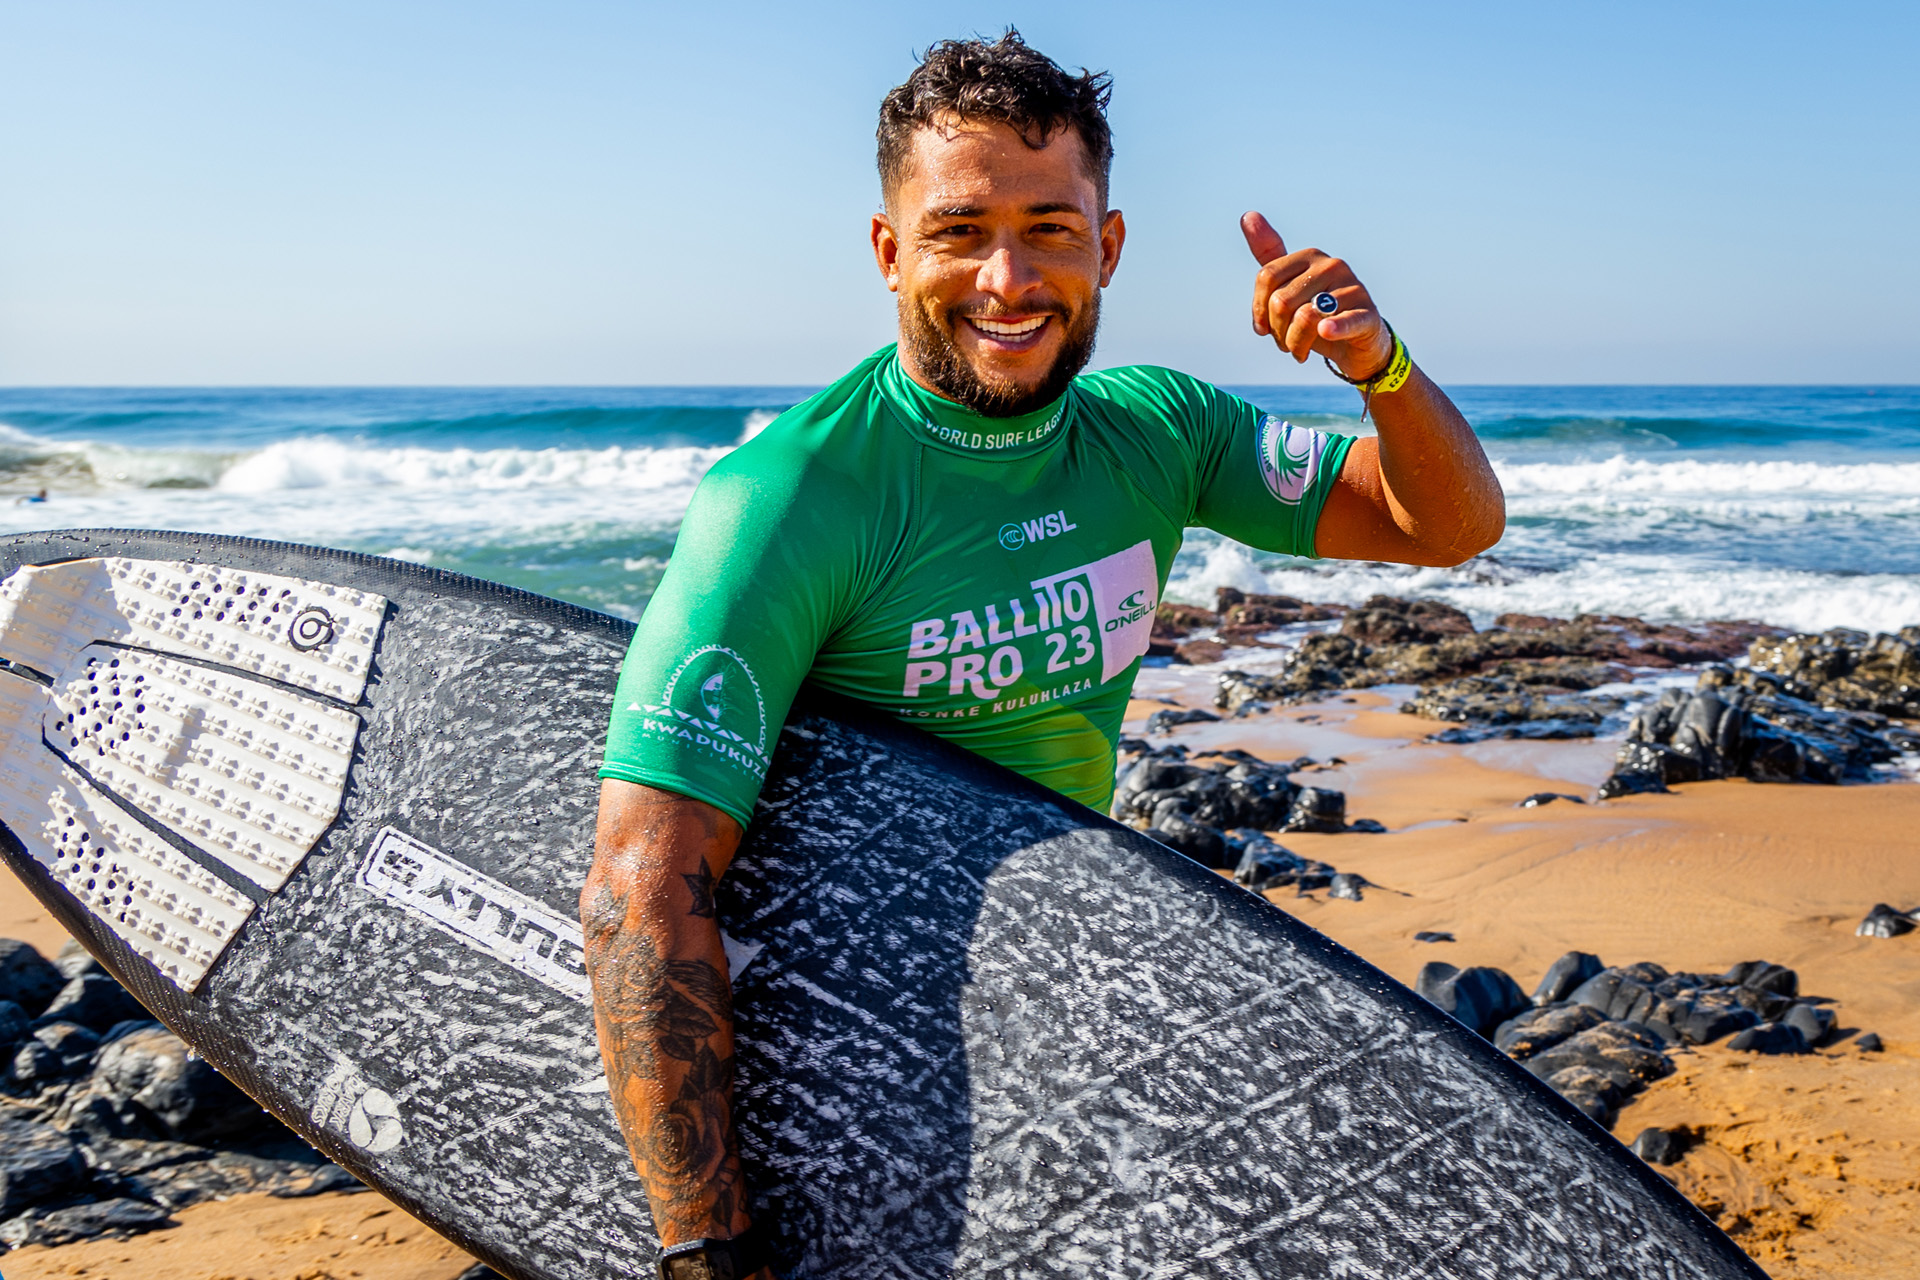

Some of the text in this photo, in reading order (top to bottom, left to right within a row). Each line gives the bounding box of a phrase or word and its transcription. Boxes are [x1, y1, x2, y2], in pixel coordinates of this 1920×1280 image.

[926, 418, 982, 449] WORLD
[985, 431, 1024, 450] SURF
[1261, 425, 1273, 472] SURFING
[1021, 509, 1077, 543] WSL
[907, 570, 1090, 659] BALLITO
[1105, 600, 1156, 632] O'NEILL
[902, 625, 1095, 699] PRO 23
[899, 678, 1092, 718] KONKE KULUHLAZA
